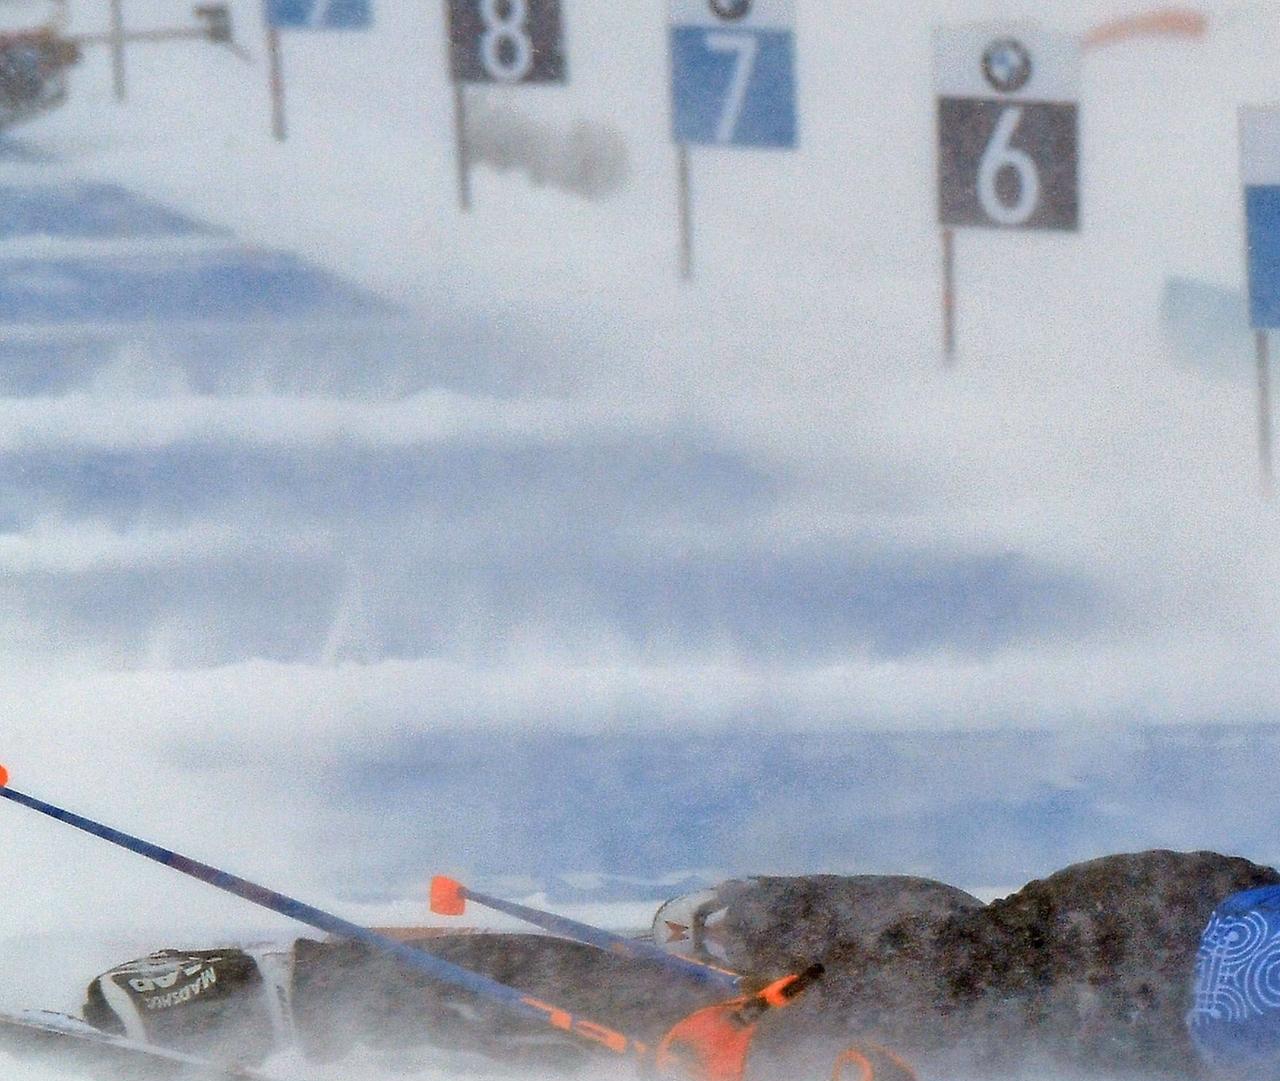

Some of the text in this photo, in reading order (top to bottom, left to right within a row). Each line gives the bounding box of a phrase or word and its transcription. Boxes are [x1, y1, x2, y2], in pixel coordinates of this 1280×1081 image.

[480, 0, 532, 82] 8
[706, 32, 757, 145] 7
[976, 106, 1040, 225] 6
